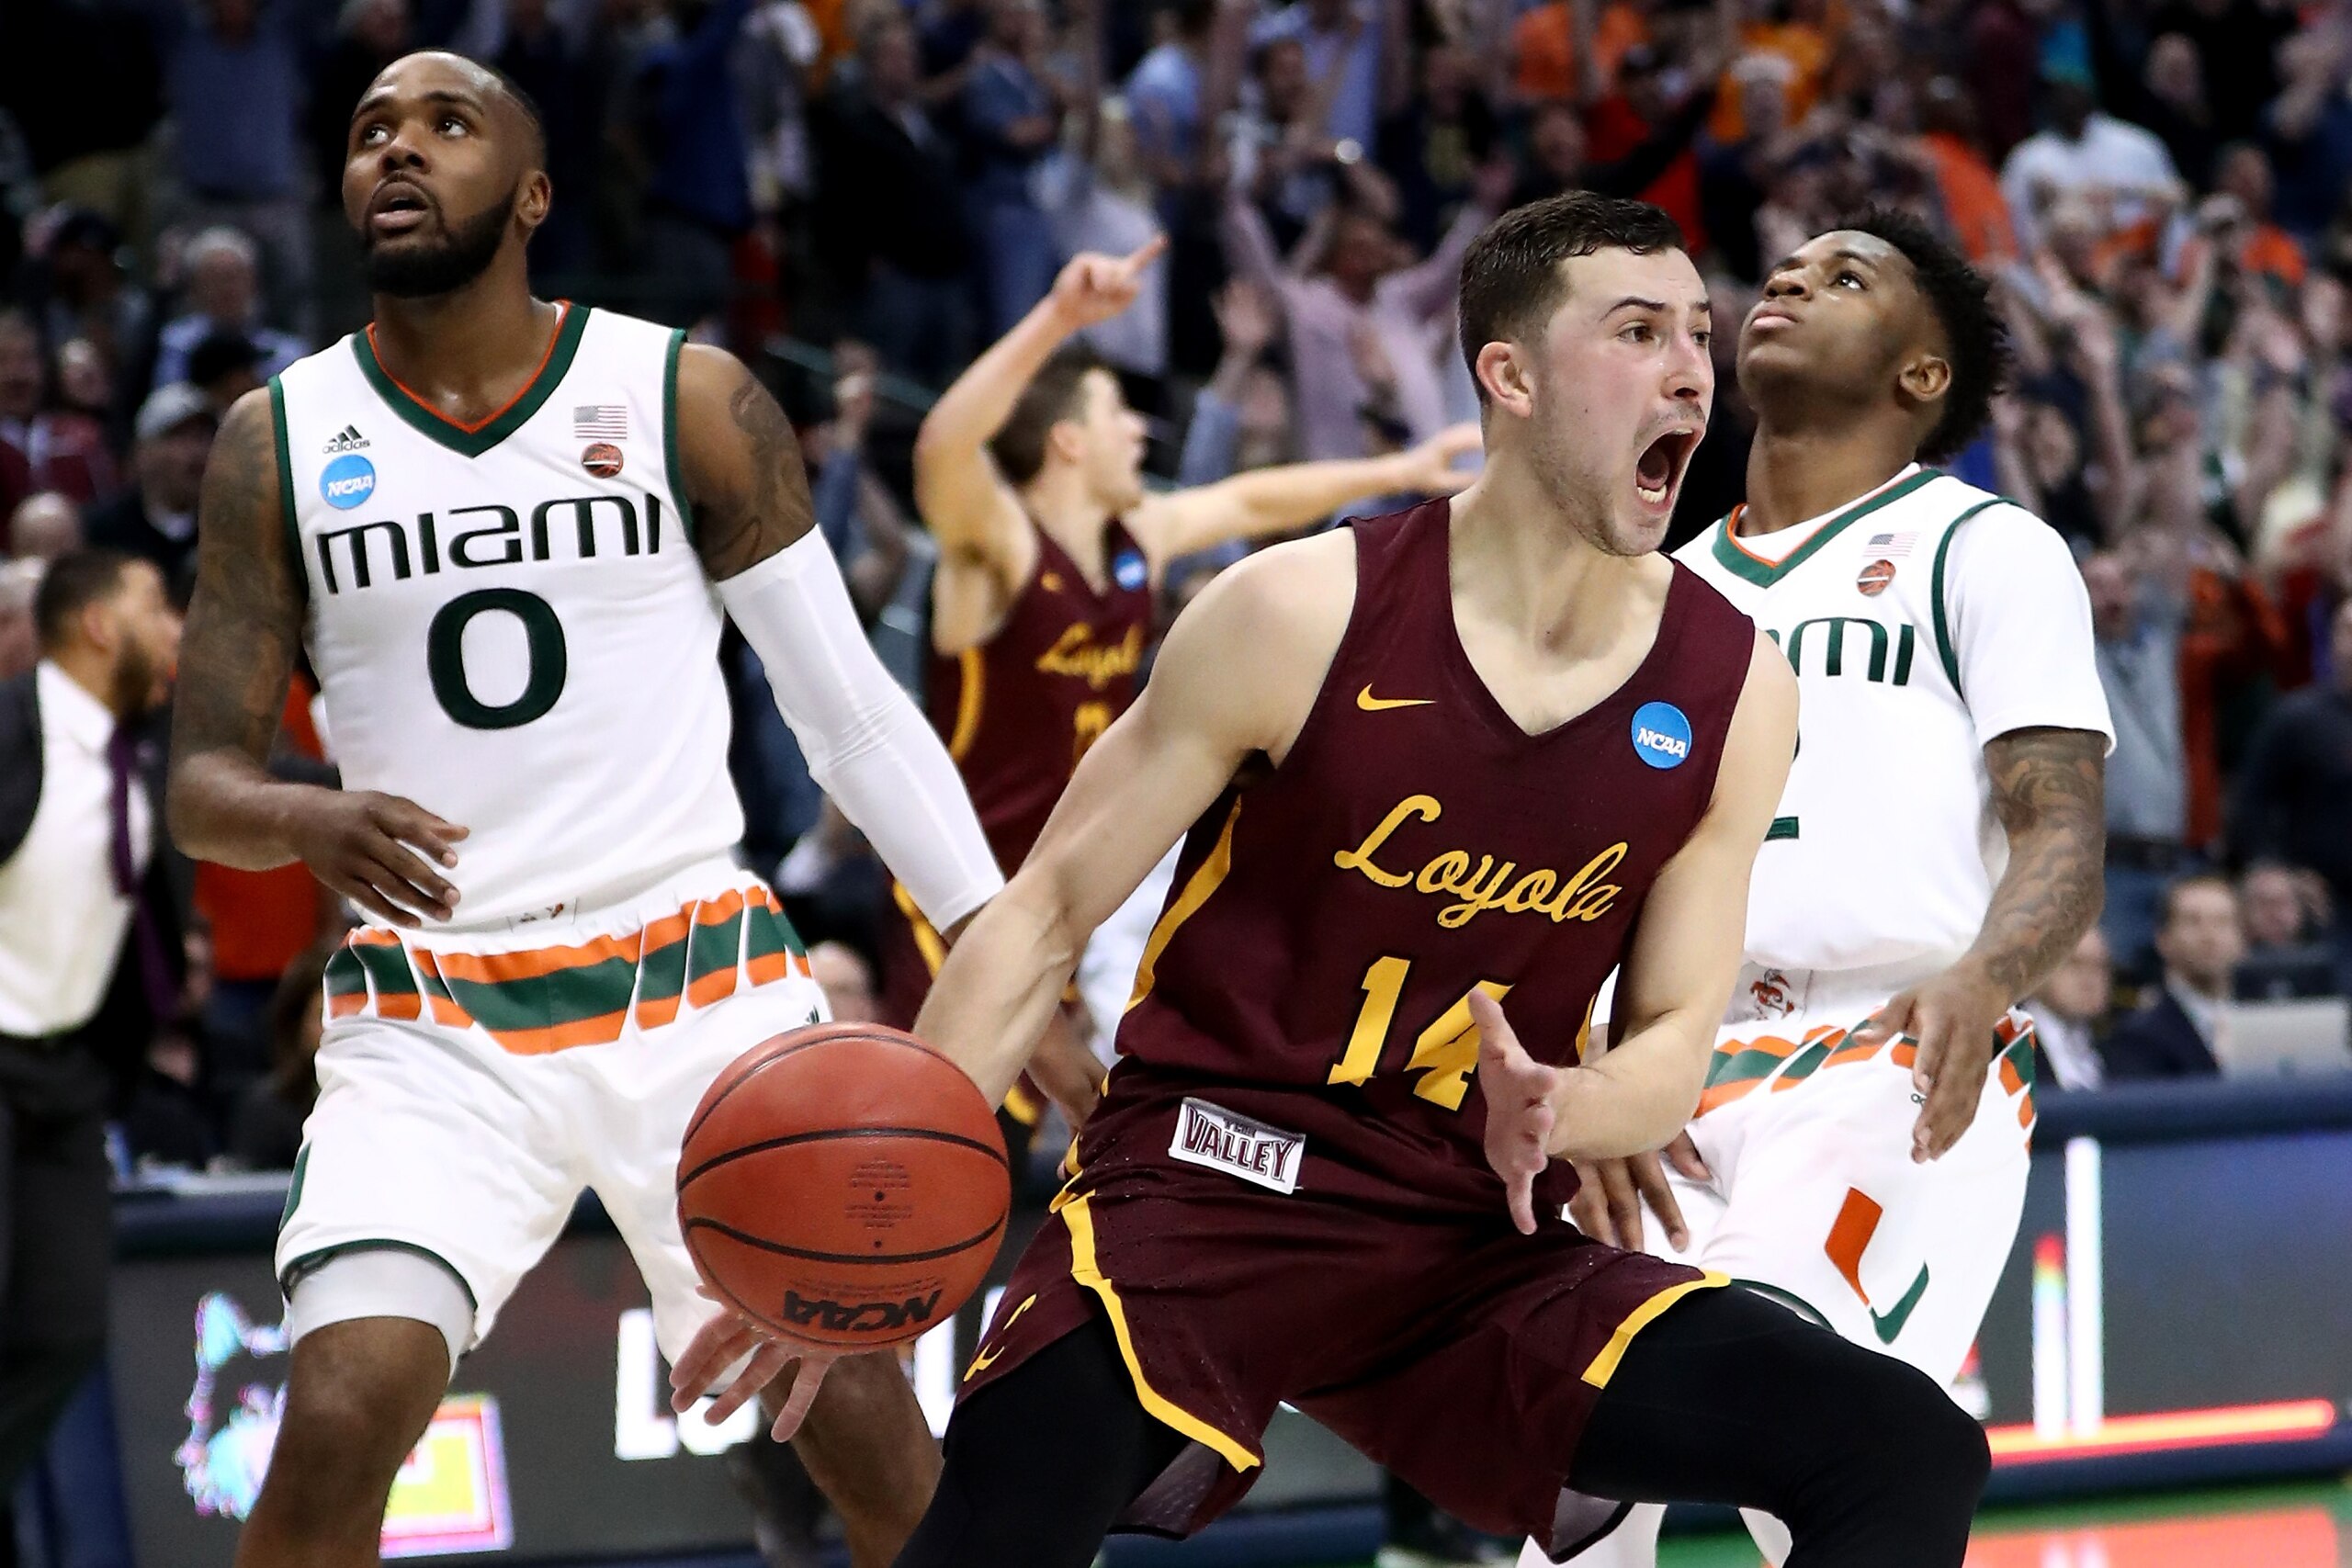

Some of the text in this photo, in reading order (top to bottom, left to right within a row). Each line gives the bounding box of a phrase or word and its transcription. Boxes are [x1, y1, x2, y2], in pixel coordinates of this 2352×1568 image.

[322, 440, 371, 454] adidas
[326, 475, 373, 498] NCAA
[426, 587, 567, 729] 0
[1636, 727, 1687, 759] NCAA
[1334, 795, 1628, 929] Loyola
[1327, 955, 1516, 1112] 14
[1182, 1105, 1296, 1182] VALLEY
[783, 1289, 944, 1331] NCAA
